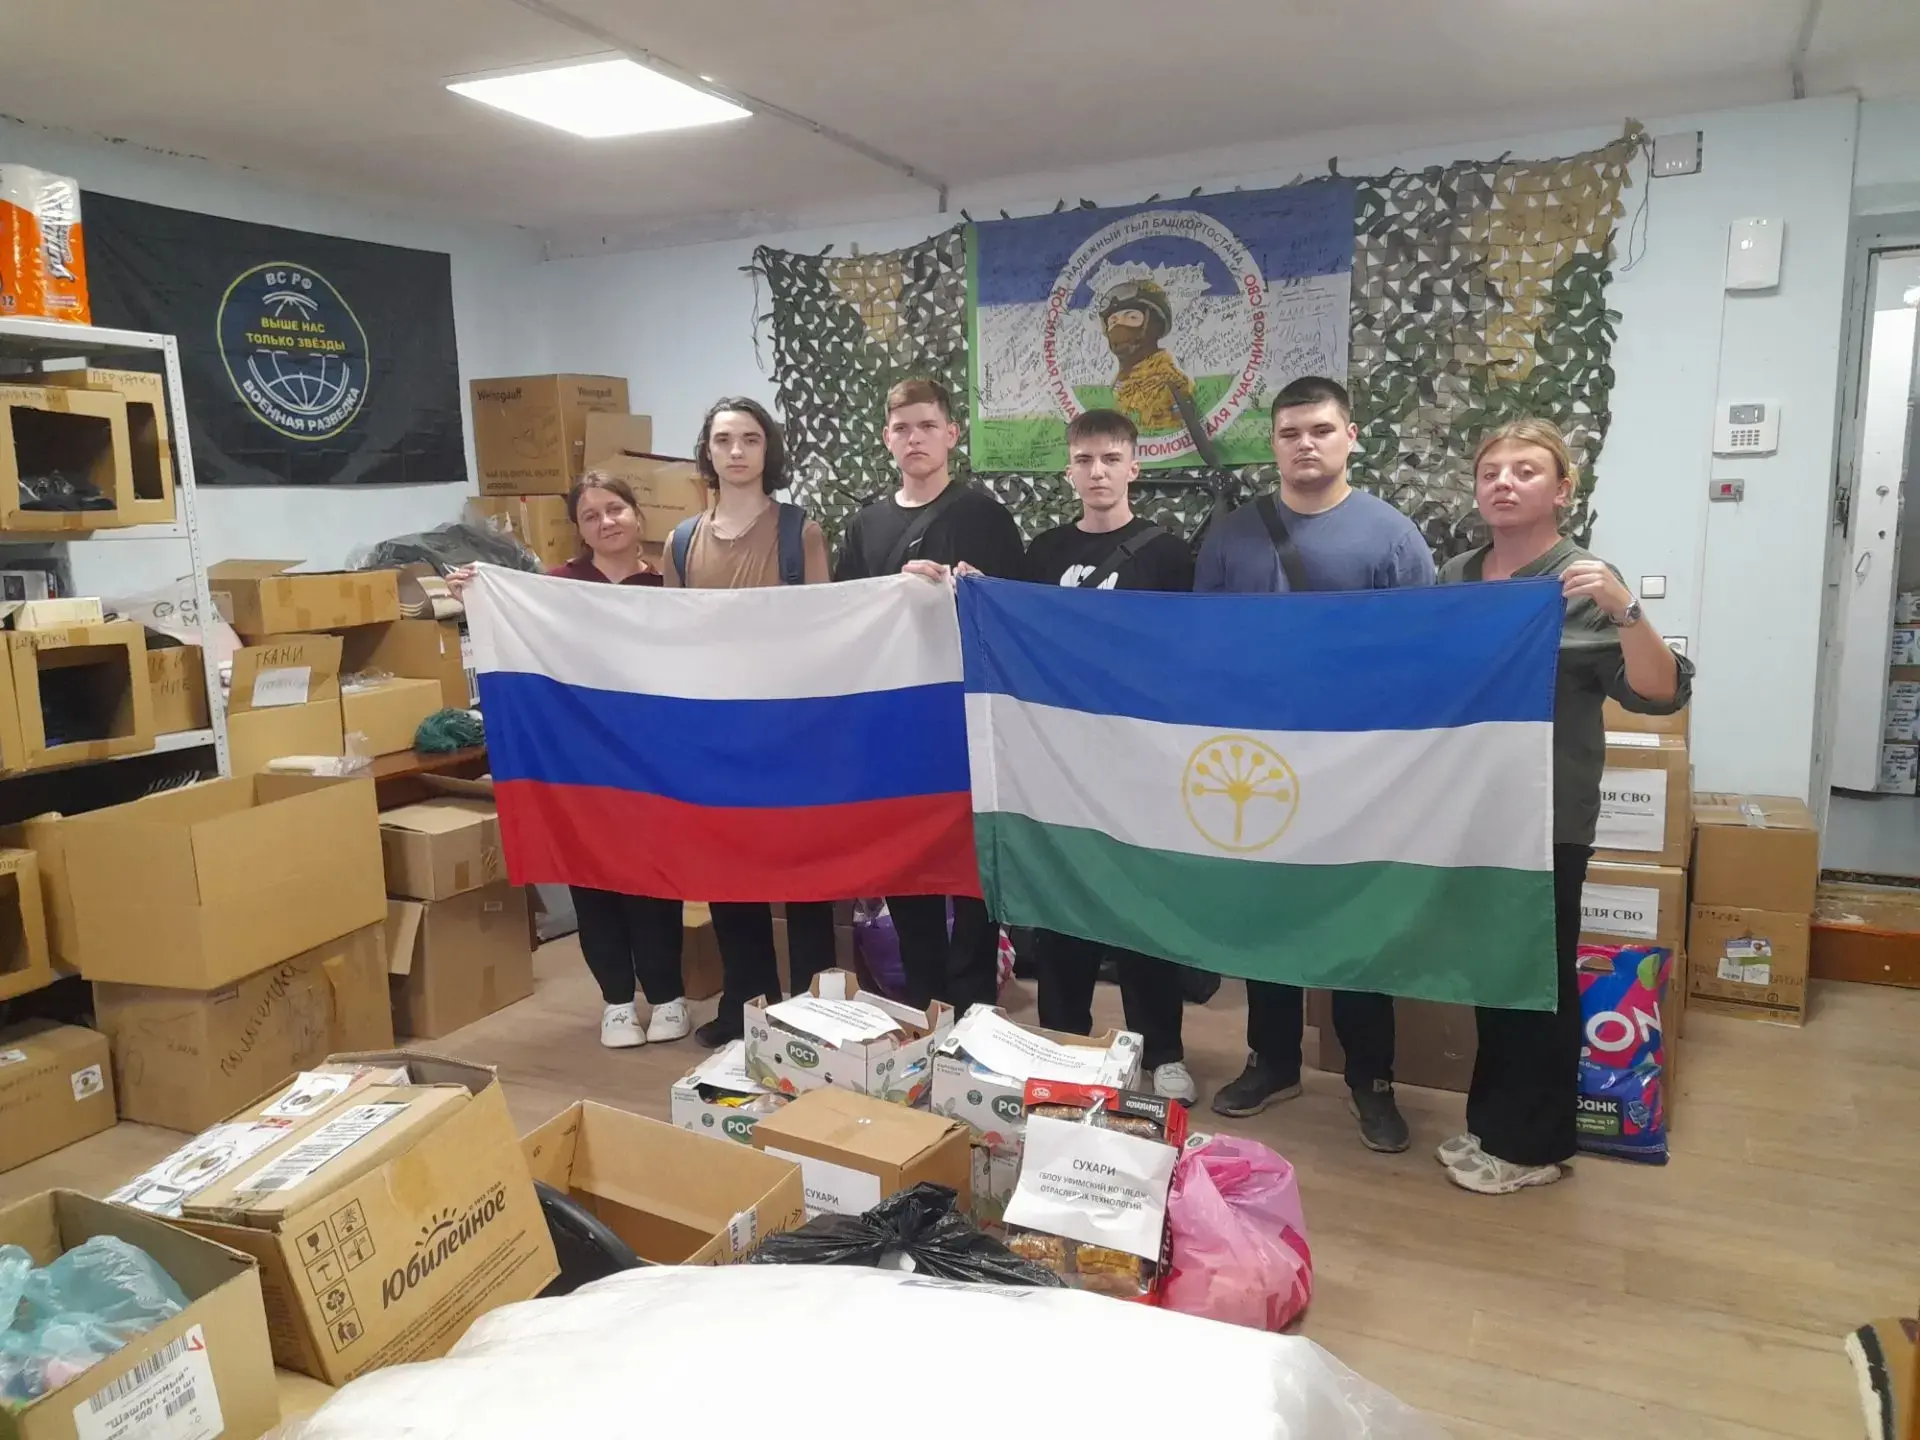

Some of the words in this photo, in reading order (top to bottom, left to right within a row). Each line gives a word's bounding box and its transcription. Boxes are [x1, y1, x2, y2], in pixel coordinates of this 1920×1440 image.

[1124, 219, 1149, 234] ТЫЛ
[1152, 217, 1244, 265] БАШКОРТОСТАНА
[265, 271, 287, 286] ВС
[291, 273, 313, 289] РФ
[1244, 274, 1262, 307] СВО
[261, 316, 299, 330] ВЫШЕ
[302, 322, 326, 333] НАС
[245, 332, 294, 347] ТОЛЬКО
[1228, 310, 1265, 407] УЧАСТНИКОВ
[242, 379, 305, 431] ВОЕННАЯ
[308, 387, 361, 432] РАЗВЕДКА
[1206, 407, 1231, 437] ДЛЯ
[1138, 435, 1195, 457] ПОМОЩ
[256, 646, 303, 668] ТКАНИ
[1600, 791, 1616, 801] ЛЯ
[1621, 792, 1651, 803] СВО
[1582, 906, 1608, 918] ДЛЯ
[1613, 909, 1643, 921] СВО
[1581, 1001, 1662, 1057] ON
[789, 1045, 816, 1063] РОСТ
[998, 1100, 1020, 1116] РО
[727, 1121, 753, 1135] РОС
[1072, 1159, 1116, 1176] СУХАРИ
[1039, 1172, 1062, 1184] ГБПОУ
[1063, 1176, 1106, 1192] УФИМСКИЙ
[805, 1187, 839, 1205] СУХАРИ
[1091, 1194, 1142, 1211] ТЕХНОЛОГИЙ
[382, 1188, 506, 1311] Юбилейное
[134, 1406, 153, 1424] 500
